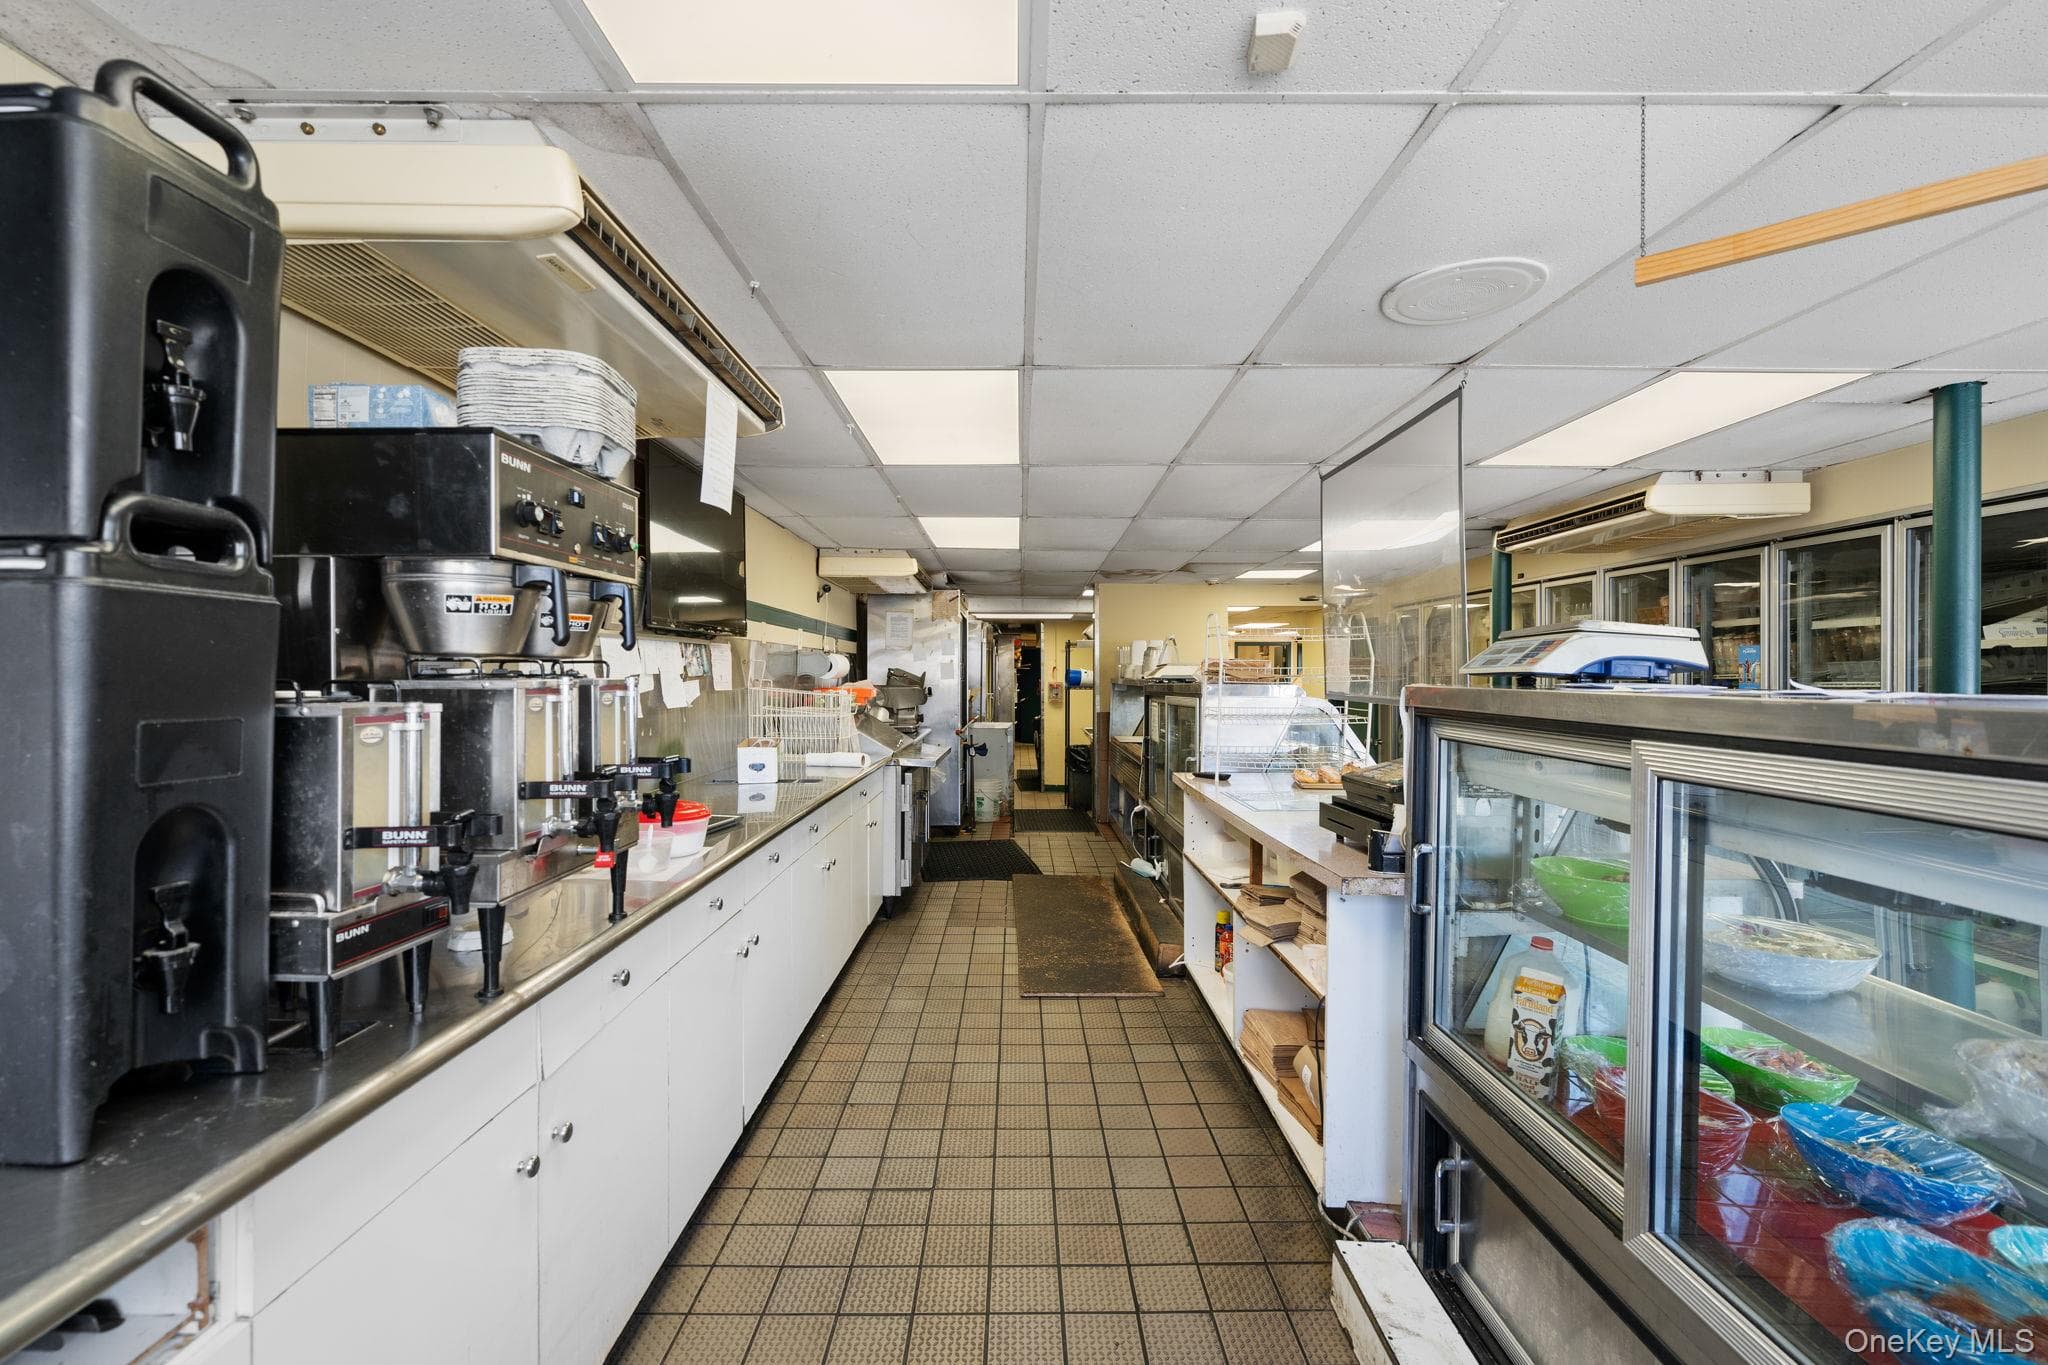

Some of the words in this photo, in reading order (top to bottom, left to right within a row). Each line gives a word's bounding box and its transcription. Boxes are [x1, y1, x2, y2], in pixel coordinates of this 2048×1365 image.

[501, 452, 531, 473] BUNN
[479, 602, 507, 610] HOT
[620, 766, 652, 774] BUNN
[549, 784, 587, 792] BUNN
[382, 831, 428, 840] BUNN
[336, 924, 370, 943] BUNN
[1516, 996, 1553, 1014] Farmland
